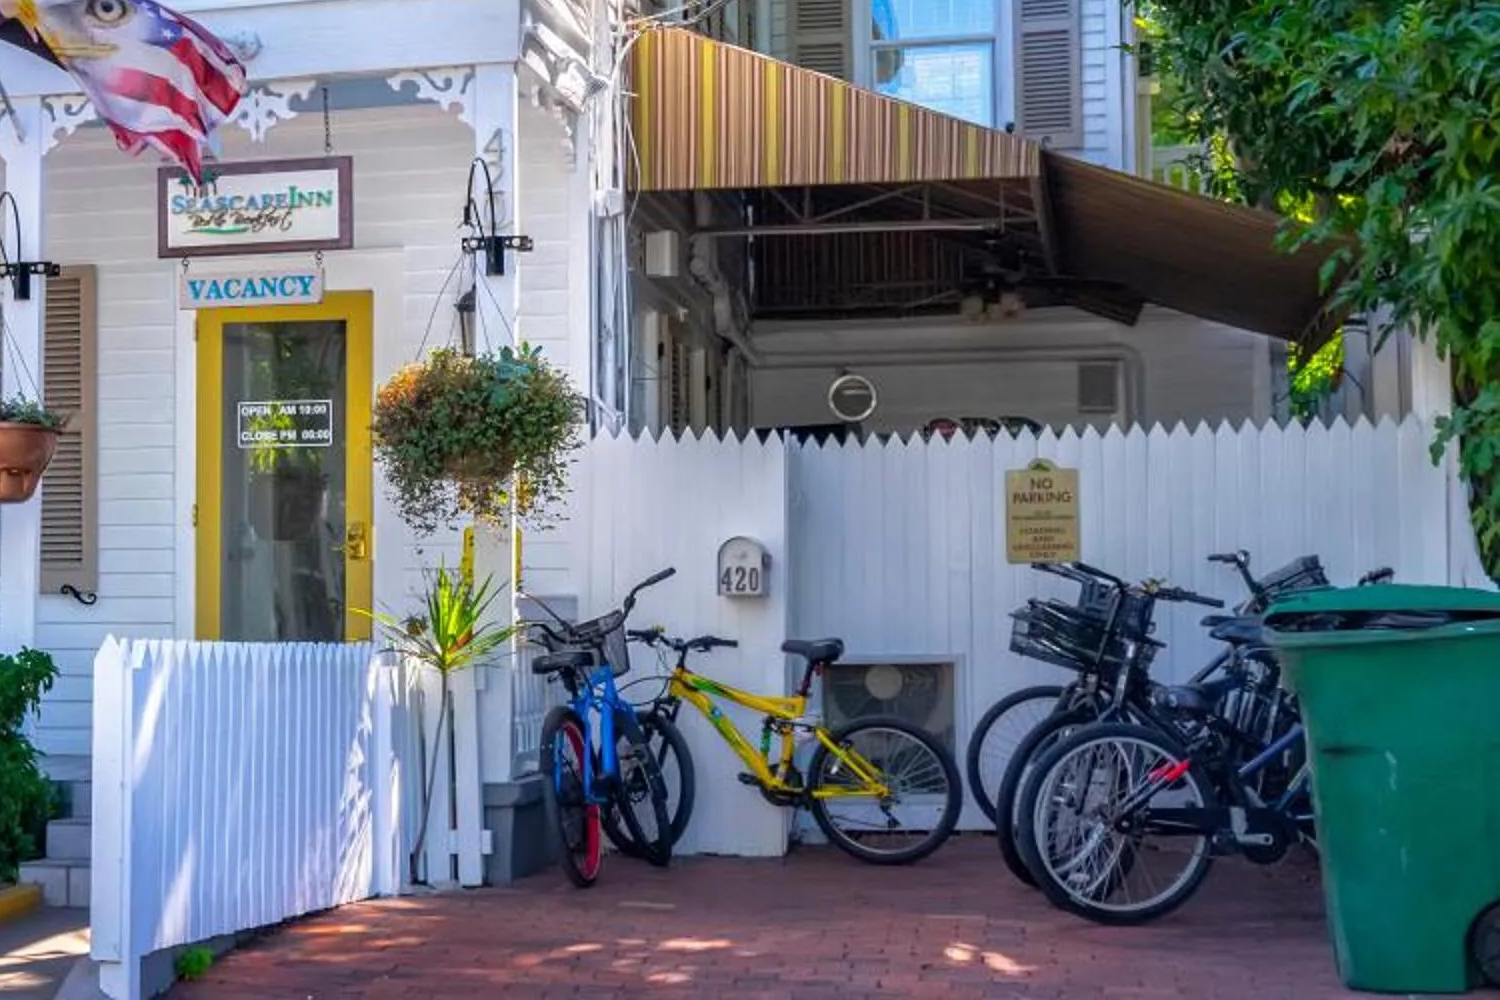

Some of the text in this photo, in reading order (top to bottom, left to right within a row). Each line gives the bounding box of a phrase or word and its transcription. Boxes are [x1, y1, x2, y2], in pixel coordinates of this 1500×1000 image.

[187, 275, 316, 301] VACANCY
[241, 406, 271, 416] OPEN
[279, 405, 296, 415] AM
[241, 430, 277, 440] CLOSE
[279, 430, 297, 440] PM
[1030, 477, 1052, 489] NO
[1013, 491, 1073, 504] PARKING
[721, 566, 759, 592] 420
